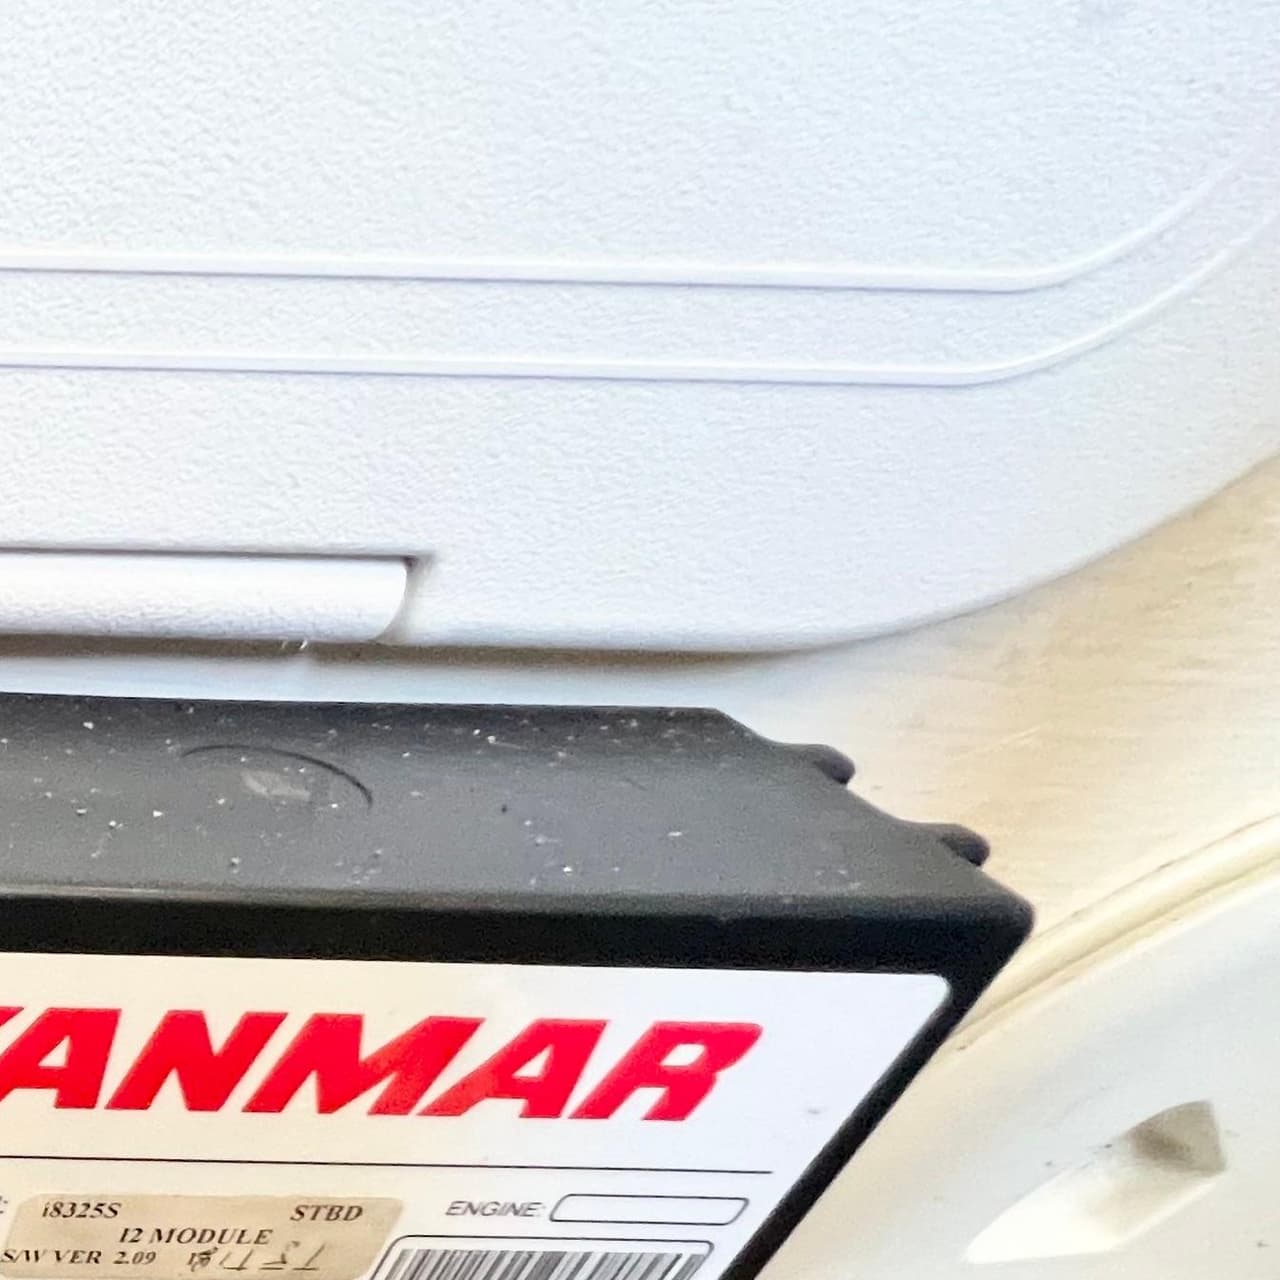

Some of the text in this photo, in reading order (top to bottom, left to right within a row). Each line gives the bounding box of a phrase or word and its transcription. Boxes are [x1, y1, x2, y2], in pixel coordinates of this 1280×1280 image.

[289, 1204, 364, 1222] STBD
[444, 1200, 546, 1217] ENGINE:
[147, 1226, 274, 1245] MODULE
[0, 1249, 158, 1265] S/W VER 2.09
